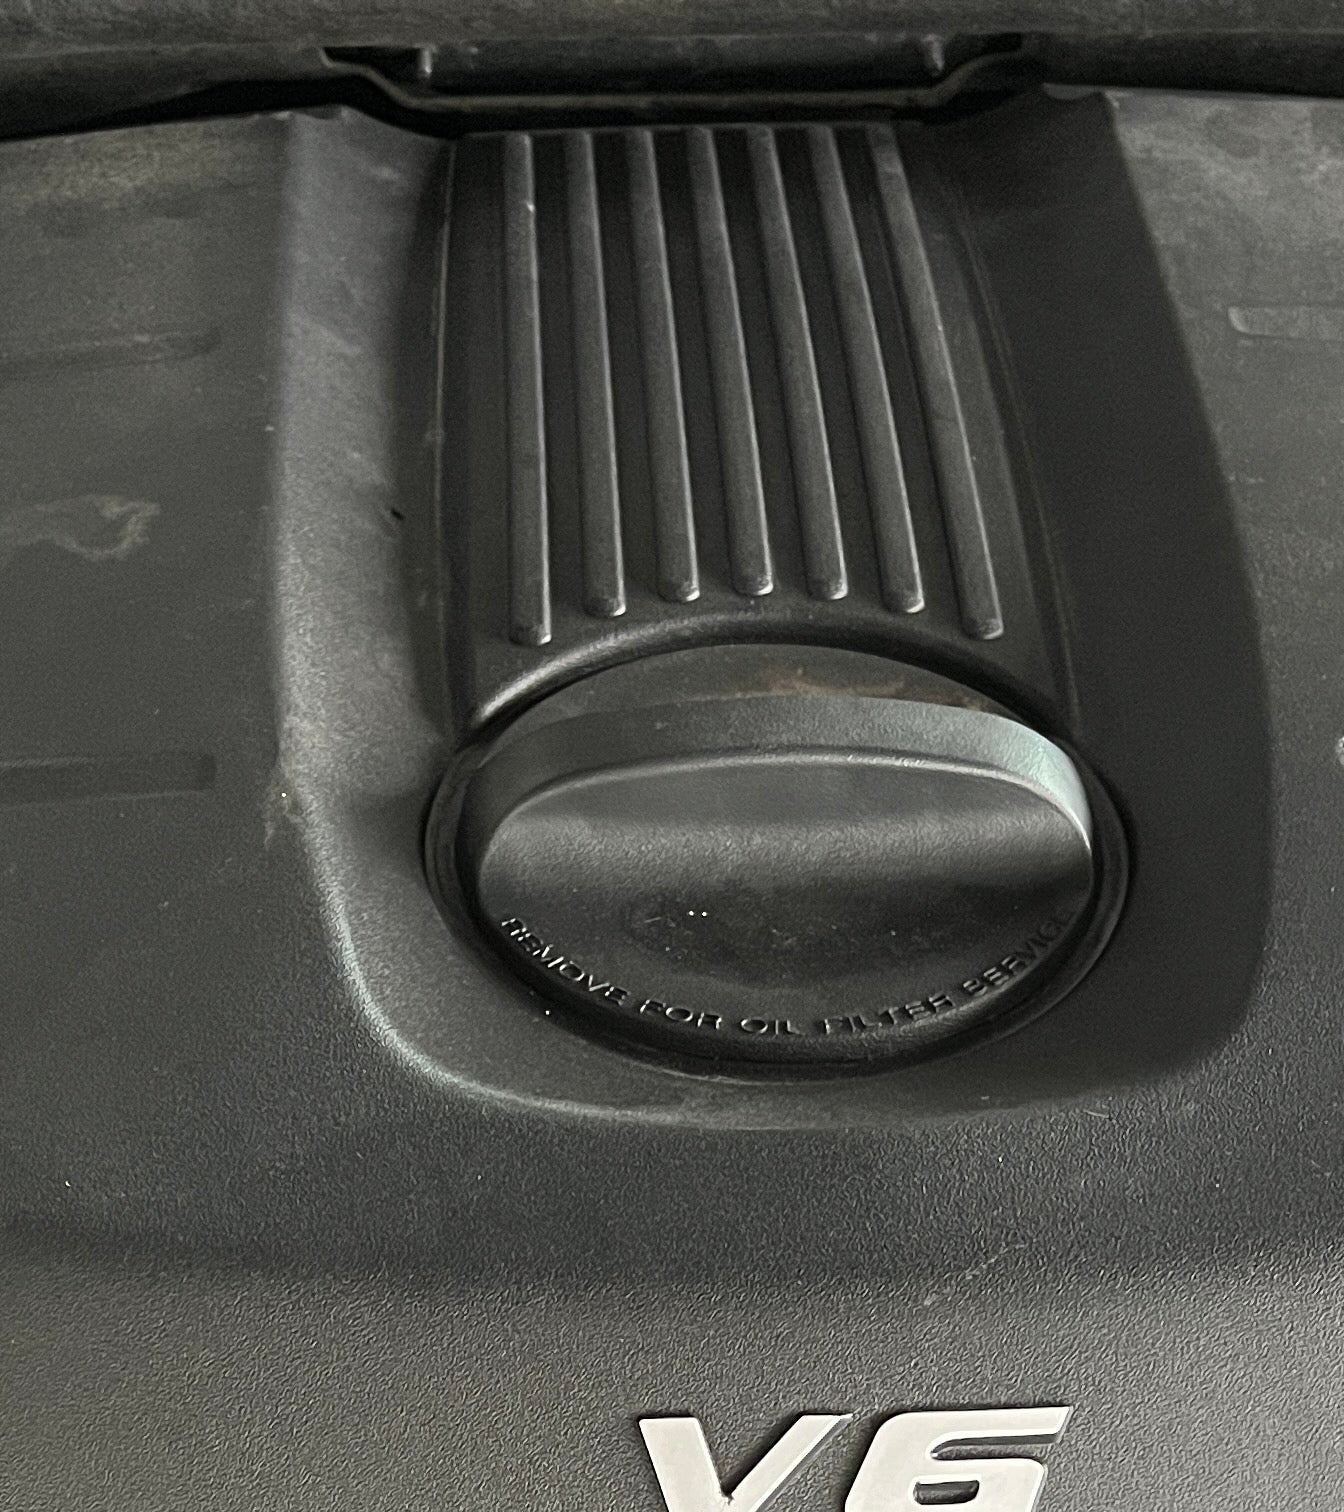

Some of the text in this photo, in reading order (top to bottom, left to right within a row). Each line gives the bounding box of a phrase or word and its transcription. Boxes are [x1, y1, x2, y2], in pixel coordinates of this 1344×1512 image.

[501, 917, 632, 1006] REMOVE
[638, 999, 723, 1030] FOR
[739, 1017, 805, 1036] OIL
[821, 991, 955, 1036] FILTER
